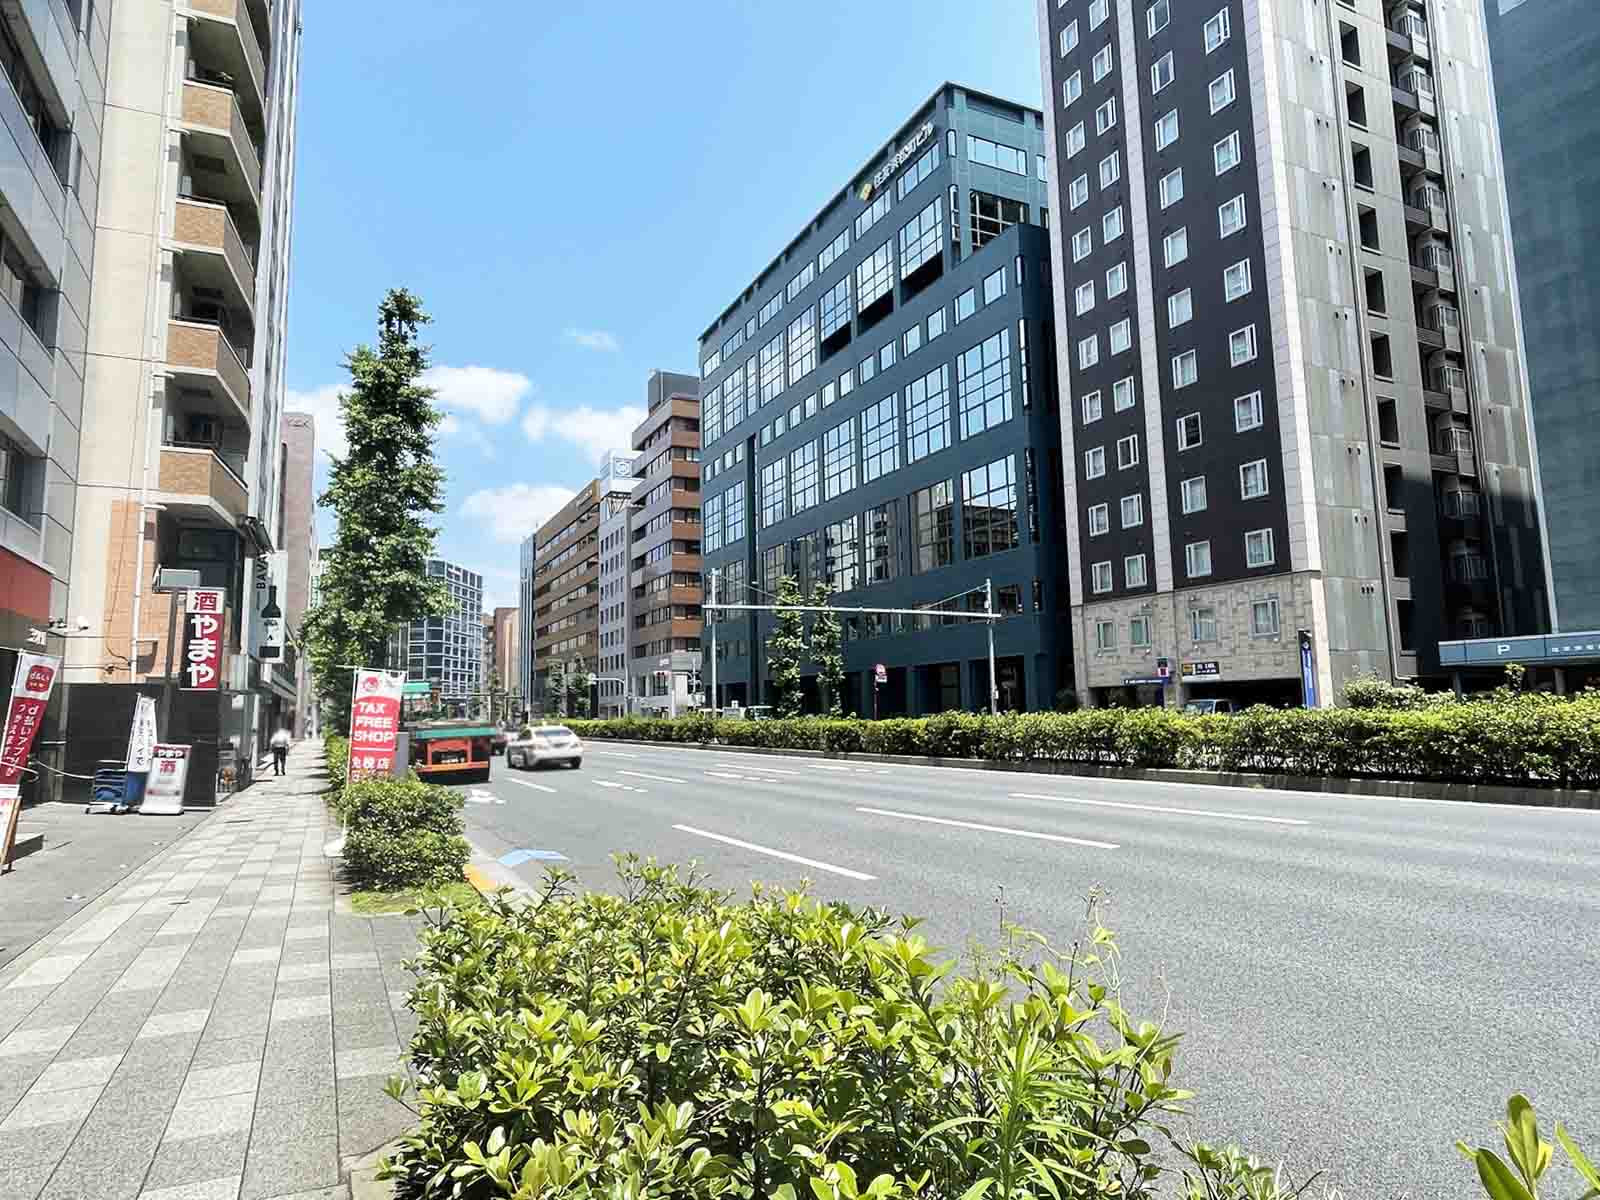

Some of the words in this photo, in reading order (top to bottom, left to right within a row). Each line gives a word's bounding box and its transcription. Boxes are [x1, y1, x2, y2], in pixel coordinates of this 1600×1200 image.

[194, 591, 218, 612] 酒
[186, 614, 218, 687] やまや
[1497, 644, 1511, 656] P
[359, 703, 385, 714] TAX
[355, 716, 393, 728] FREE
[353, 731, 394, 743] SHOP
